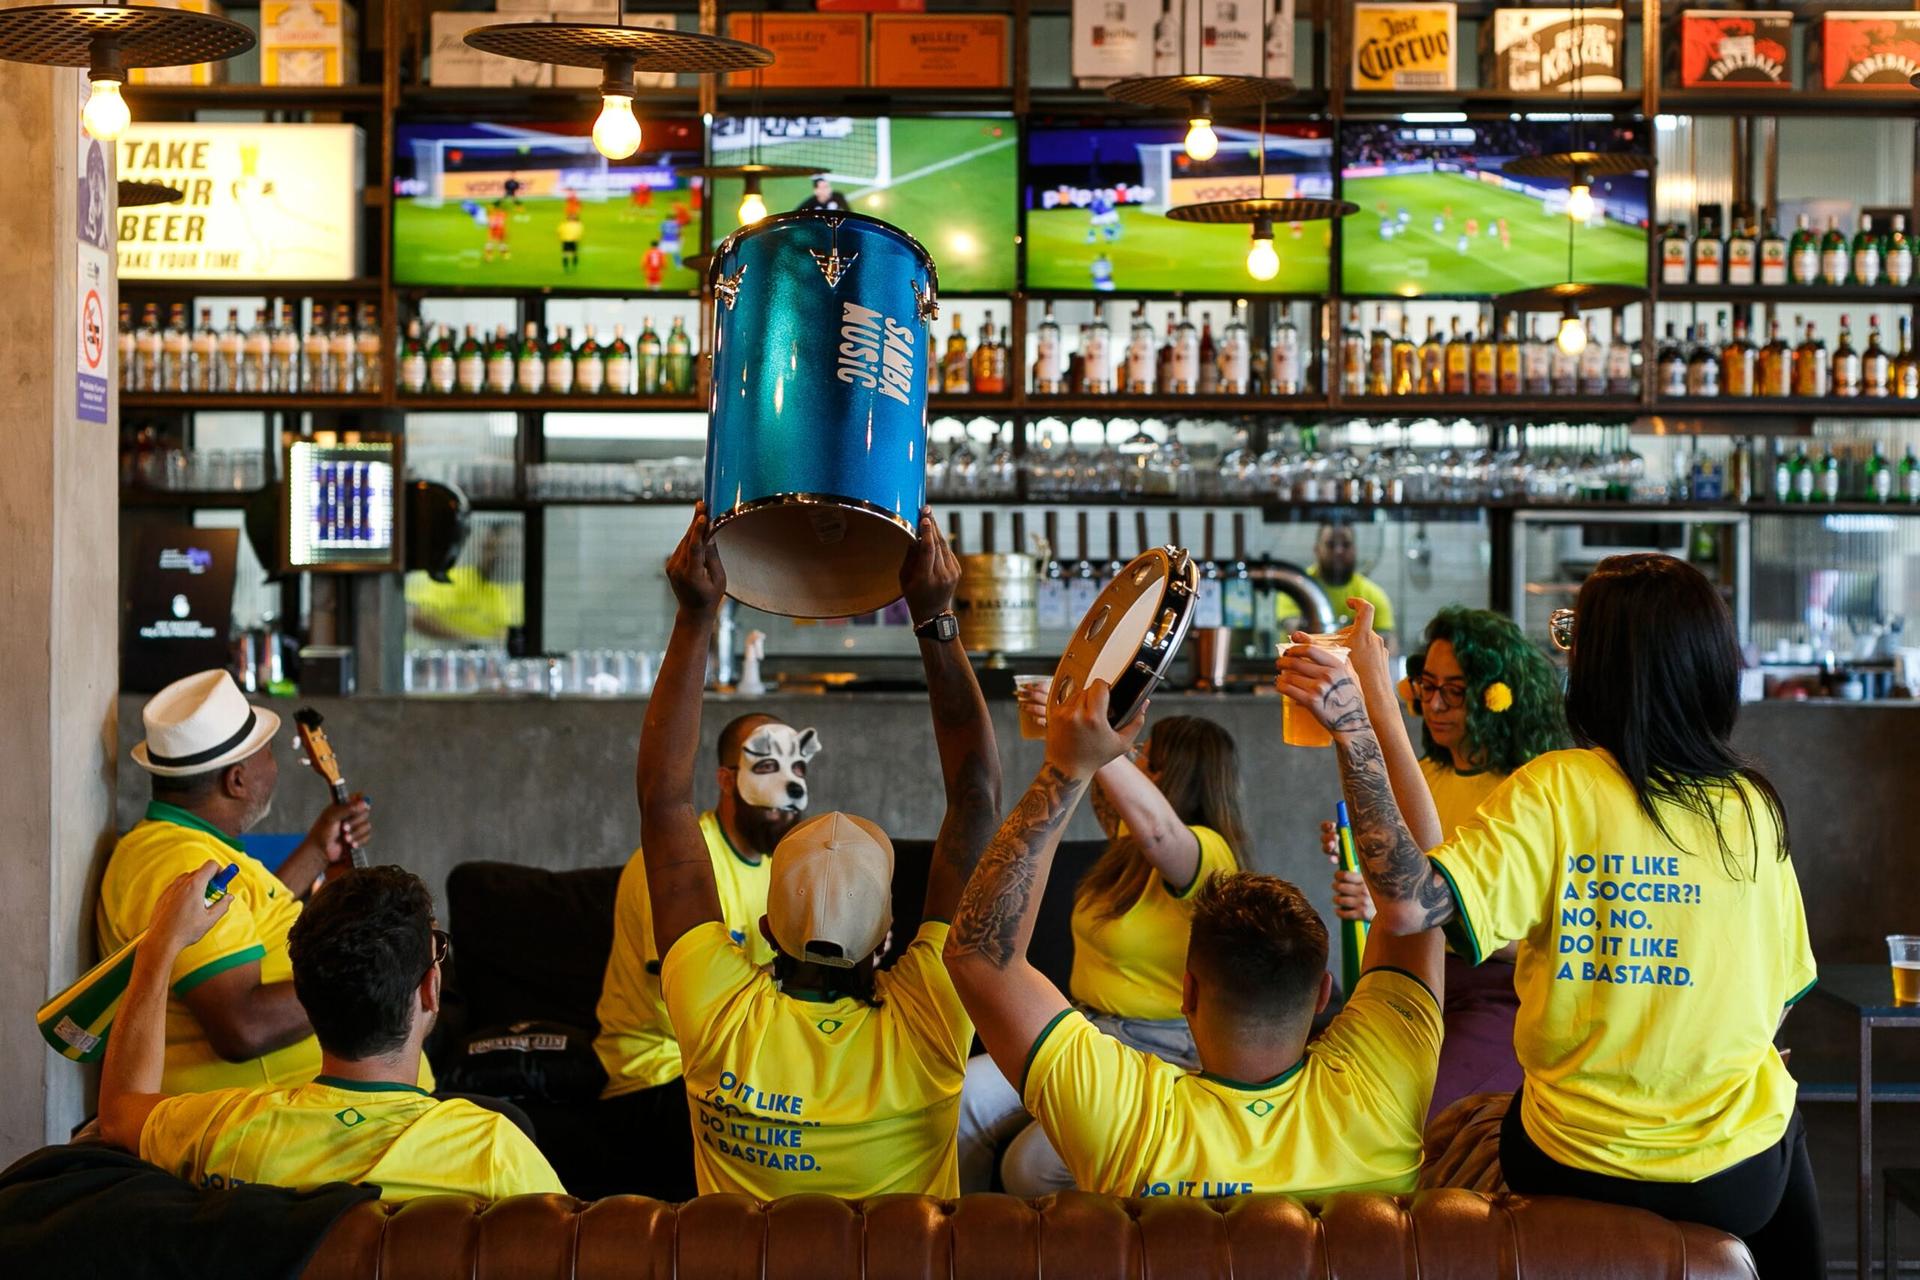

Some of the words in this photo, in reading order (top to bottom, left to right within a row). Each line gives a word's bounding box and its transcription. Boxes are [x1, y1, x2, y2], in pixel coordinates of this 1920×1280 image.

[124, 141, 210, 169] TAKE
[119, 215, 206, 242] BEER
[878, 317, 915, 405] SAMBA
[1603, 854, 1625, 874] IT
[1631, 855, 1680, 877] LIKE
[1563, 881, 1580, 900] A
[1586, 880, 1701, 904] SOCCER?!
[1561, 907, 1602, 931] NO,
[1609, 909, 1653, 930] NO.
[1558, 934, 1595, 954] DO
[1601, 936, 1623, 956] IT
[1629, 938, 1679, 959] LIKE
[1555, 961, 1575, 981] A
[1581, 961, 1694, 987] BASTARD.
[734, 1082, 755, 1105] IT
[755, 1091, 804, 1116] LIKE
[700, 1109, 726, 1133] DO
[730, 1123, 749, 1140] IT
[754, 1127, 803, 1149] LIKE
[718, 1138, 822, 1172] BASTARD.
[1177, 1181, 1198, 1197] IT
[1202, 1181, 1253, 1199] LIKE
